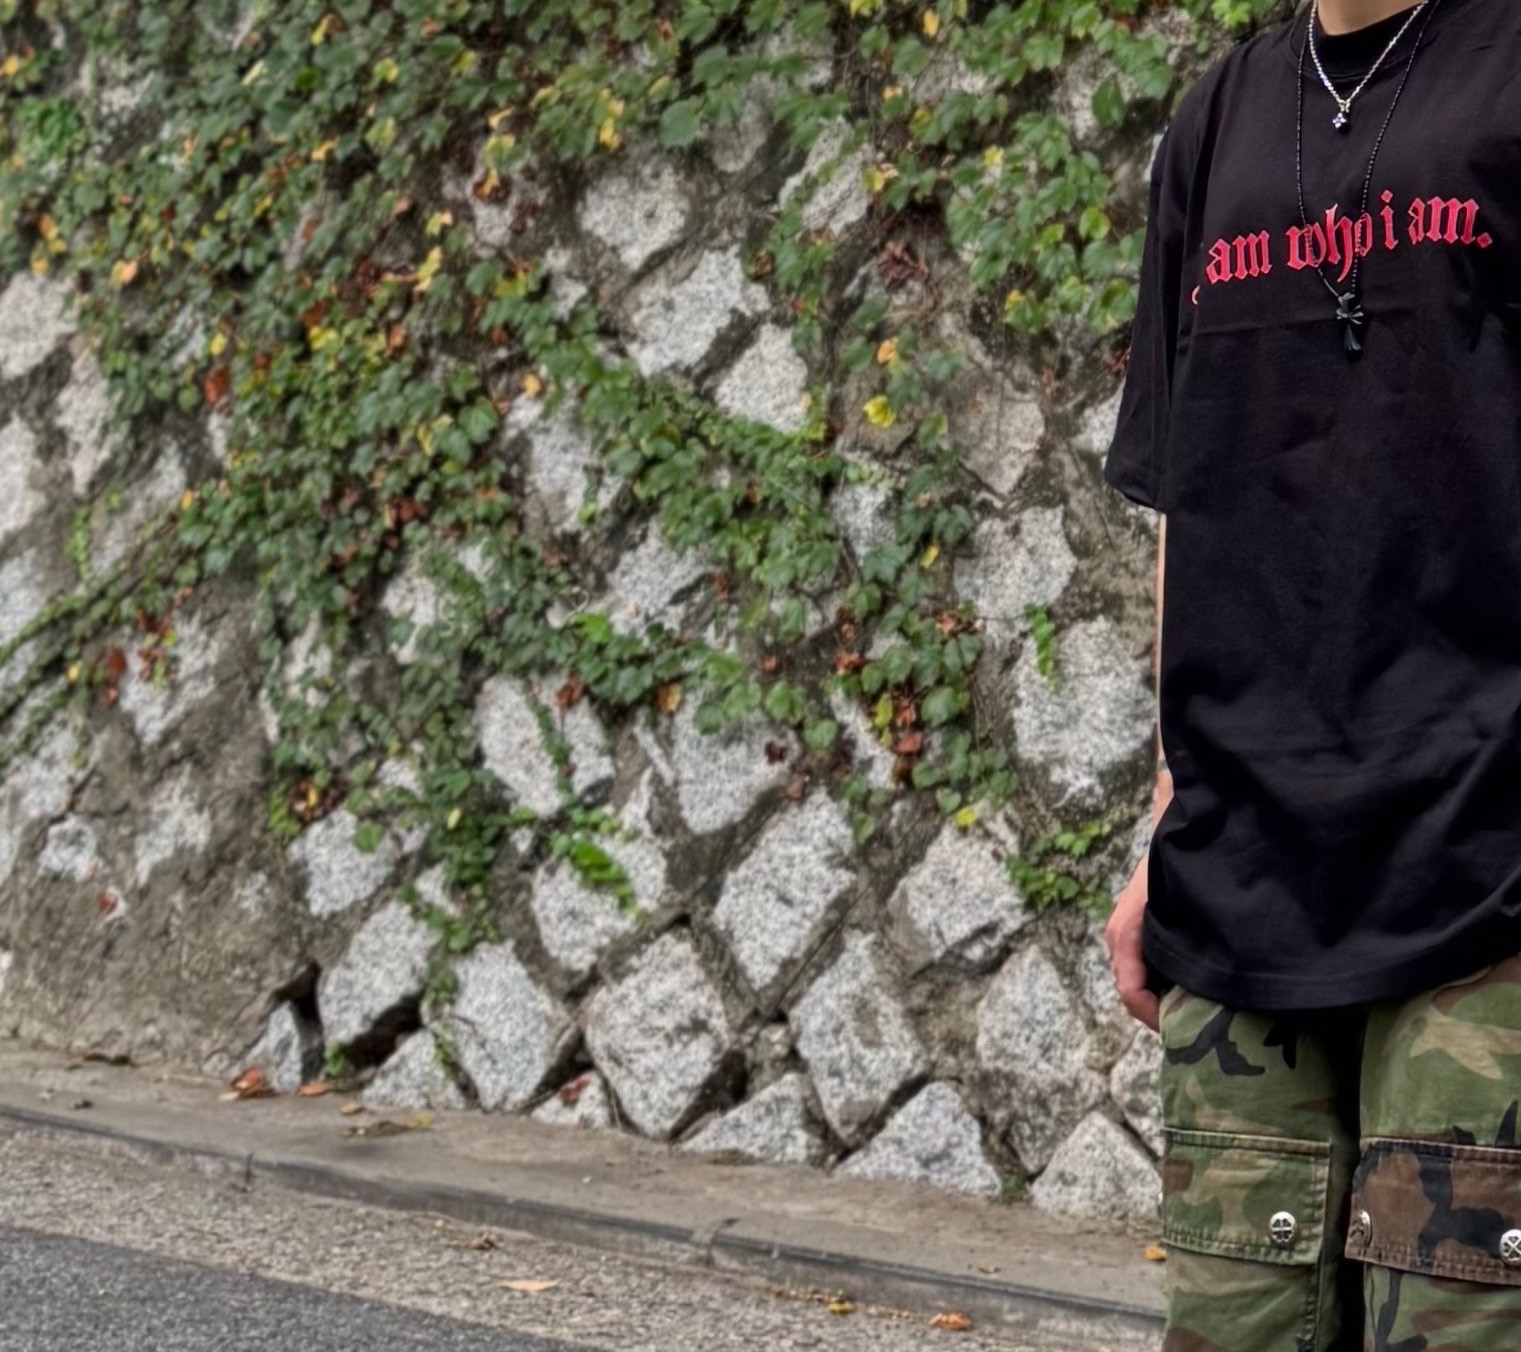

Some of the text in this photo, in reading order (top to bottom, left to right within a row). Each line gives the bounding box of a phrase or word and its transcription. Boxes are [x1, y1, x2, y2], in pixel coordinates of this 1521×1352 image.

[1205, 189, 1493, 285] am who i am.
